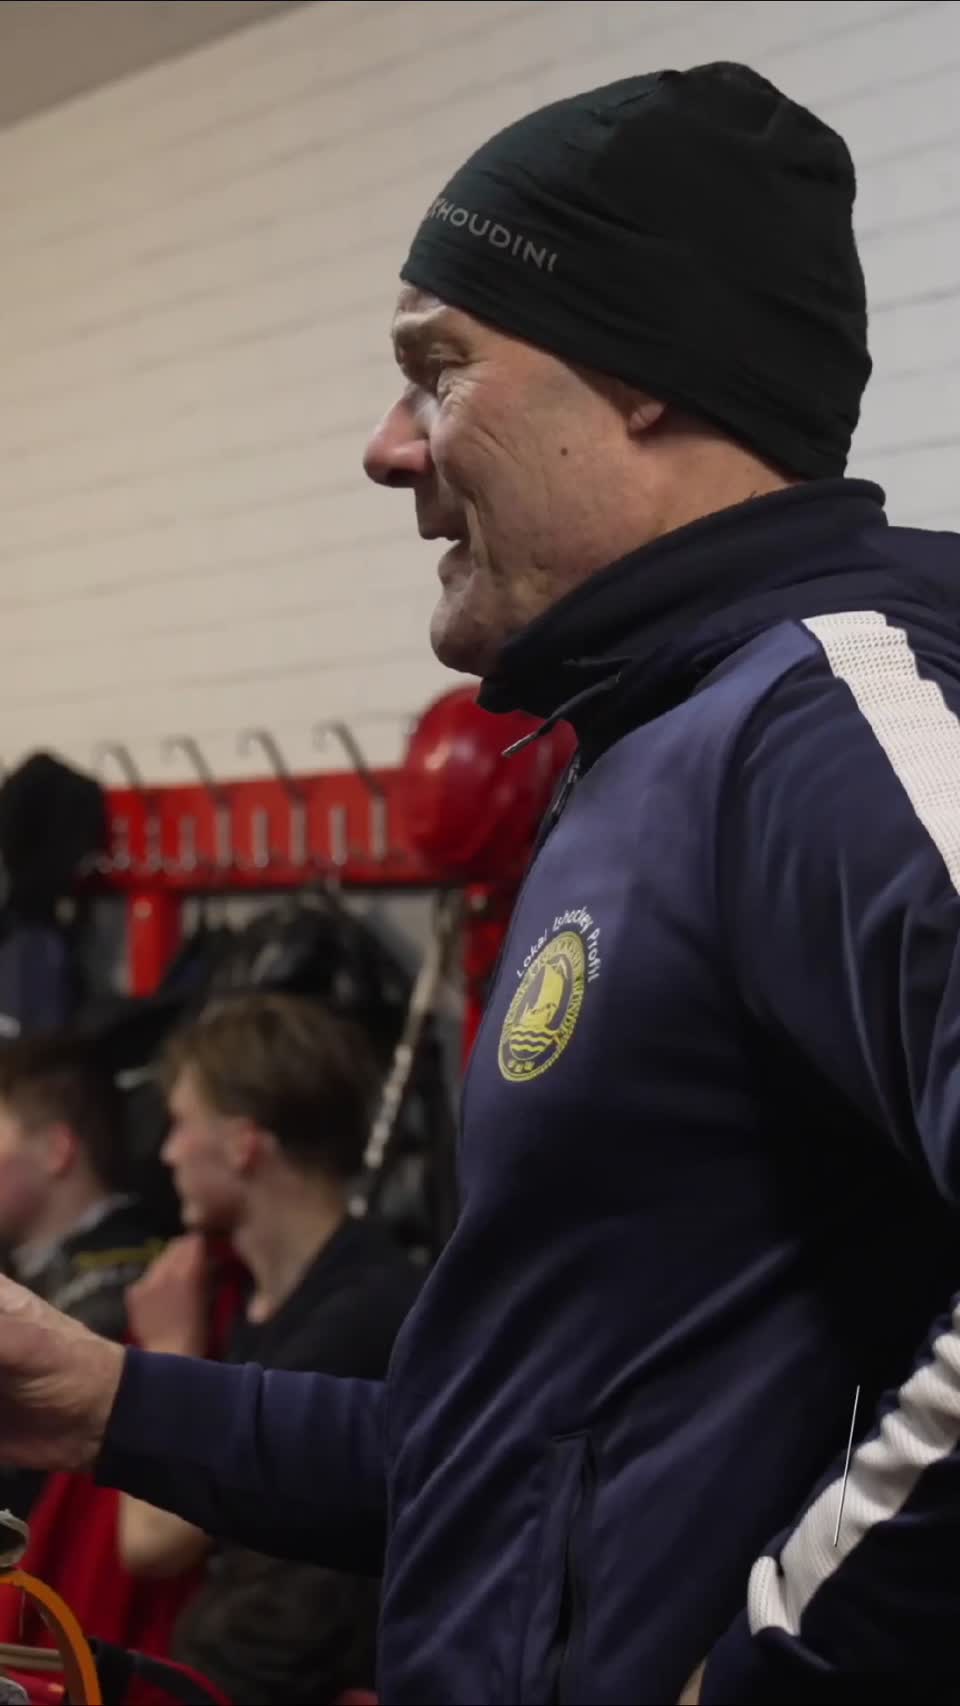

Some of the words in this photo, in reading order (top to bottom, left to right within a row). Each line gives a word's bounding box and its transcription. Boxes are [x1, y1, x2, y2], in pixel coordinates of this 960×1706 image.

[435, 200, 558, 272] HOUDINI
[516, 928, 548, 979] Lokal
[587, 927, 602, 983] Profil
